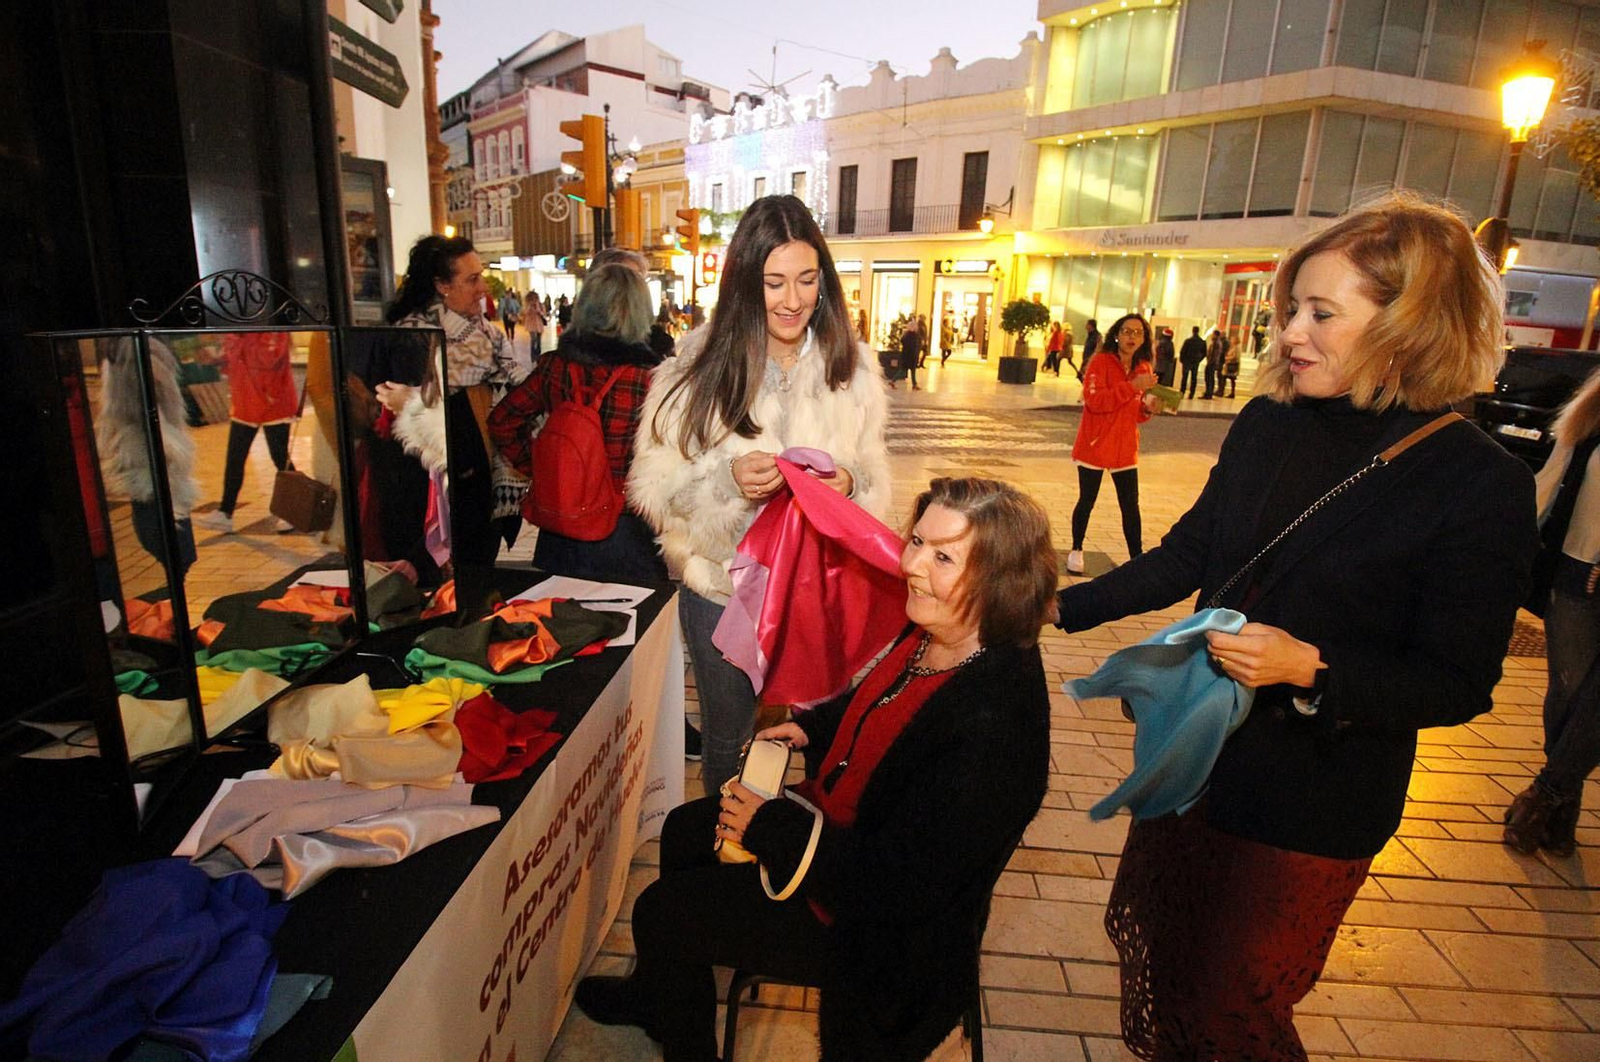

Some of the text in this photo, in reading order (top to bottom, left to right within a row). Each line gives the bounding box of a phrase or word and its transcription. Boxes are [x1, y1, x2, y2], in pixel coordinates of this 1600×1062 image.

[1117, 230, 1189, 247] Santander
[479, 719, 643, 1013] compras Navideñas
[502, 700, 633, 916] Asesoramos tus
[496, 972, 512, 1035] el
[516, 866, 582, 984] Centro
[586, 827, 606, 871] de
